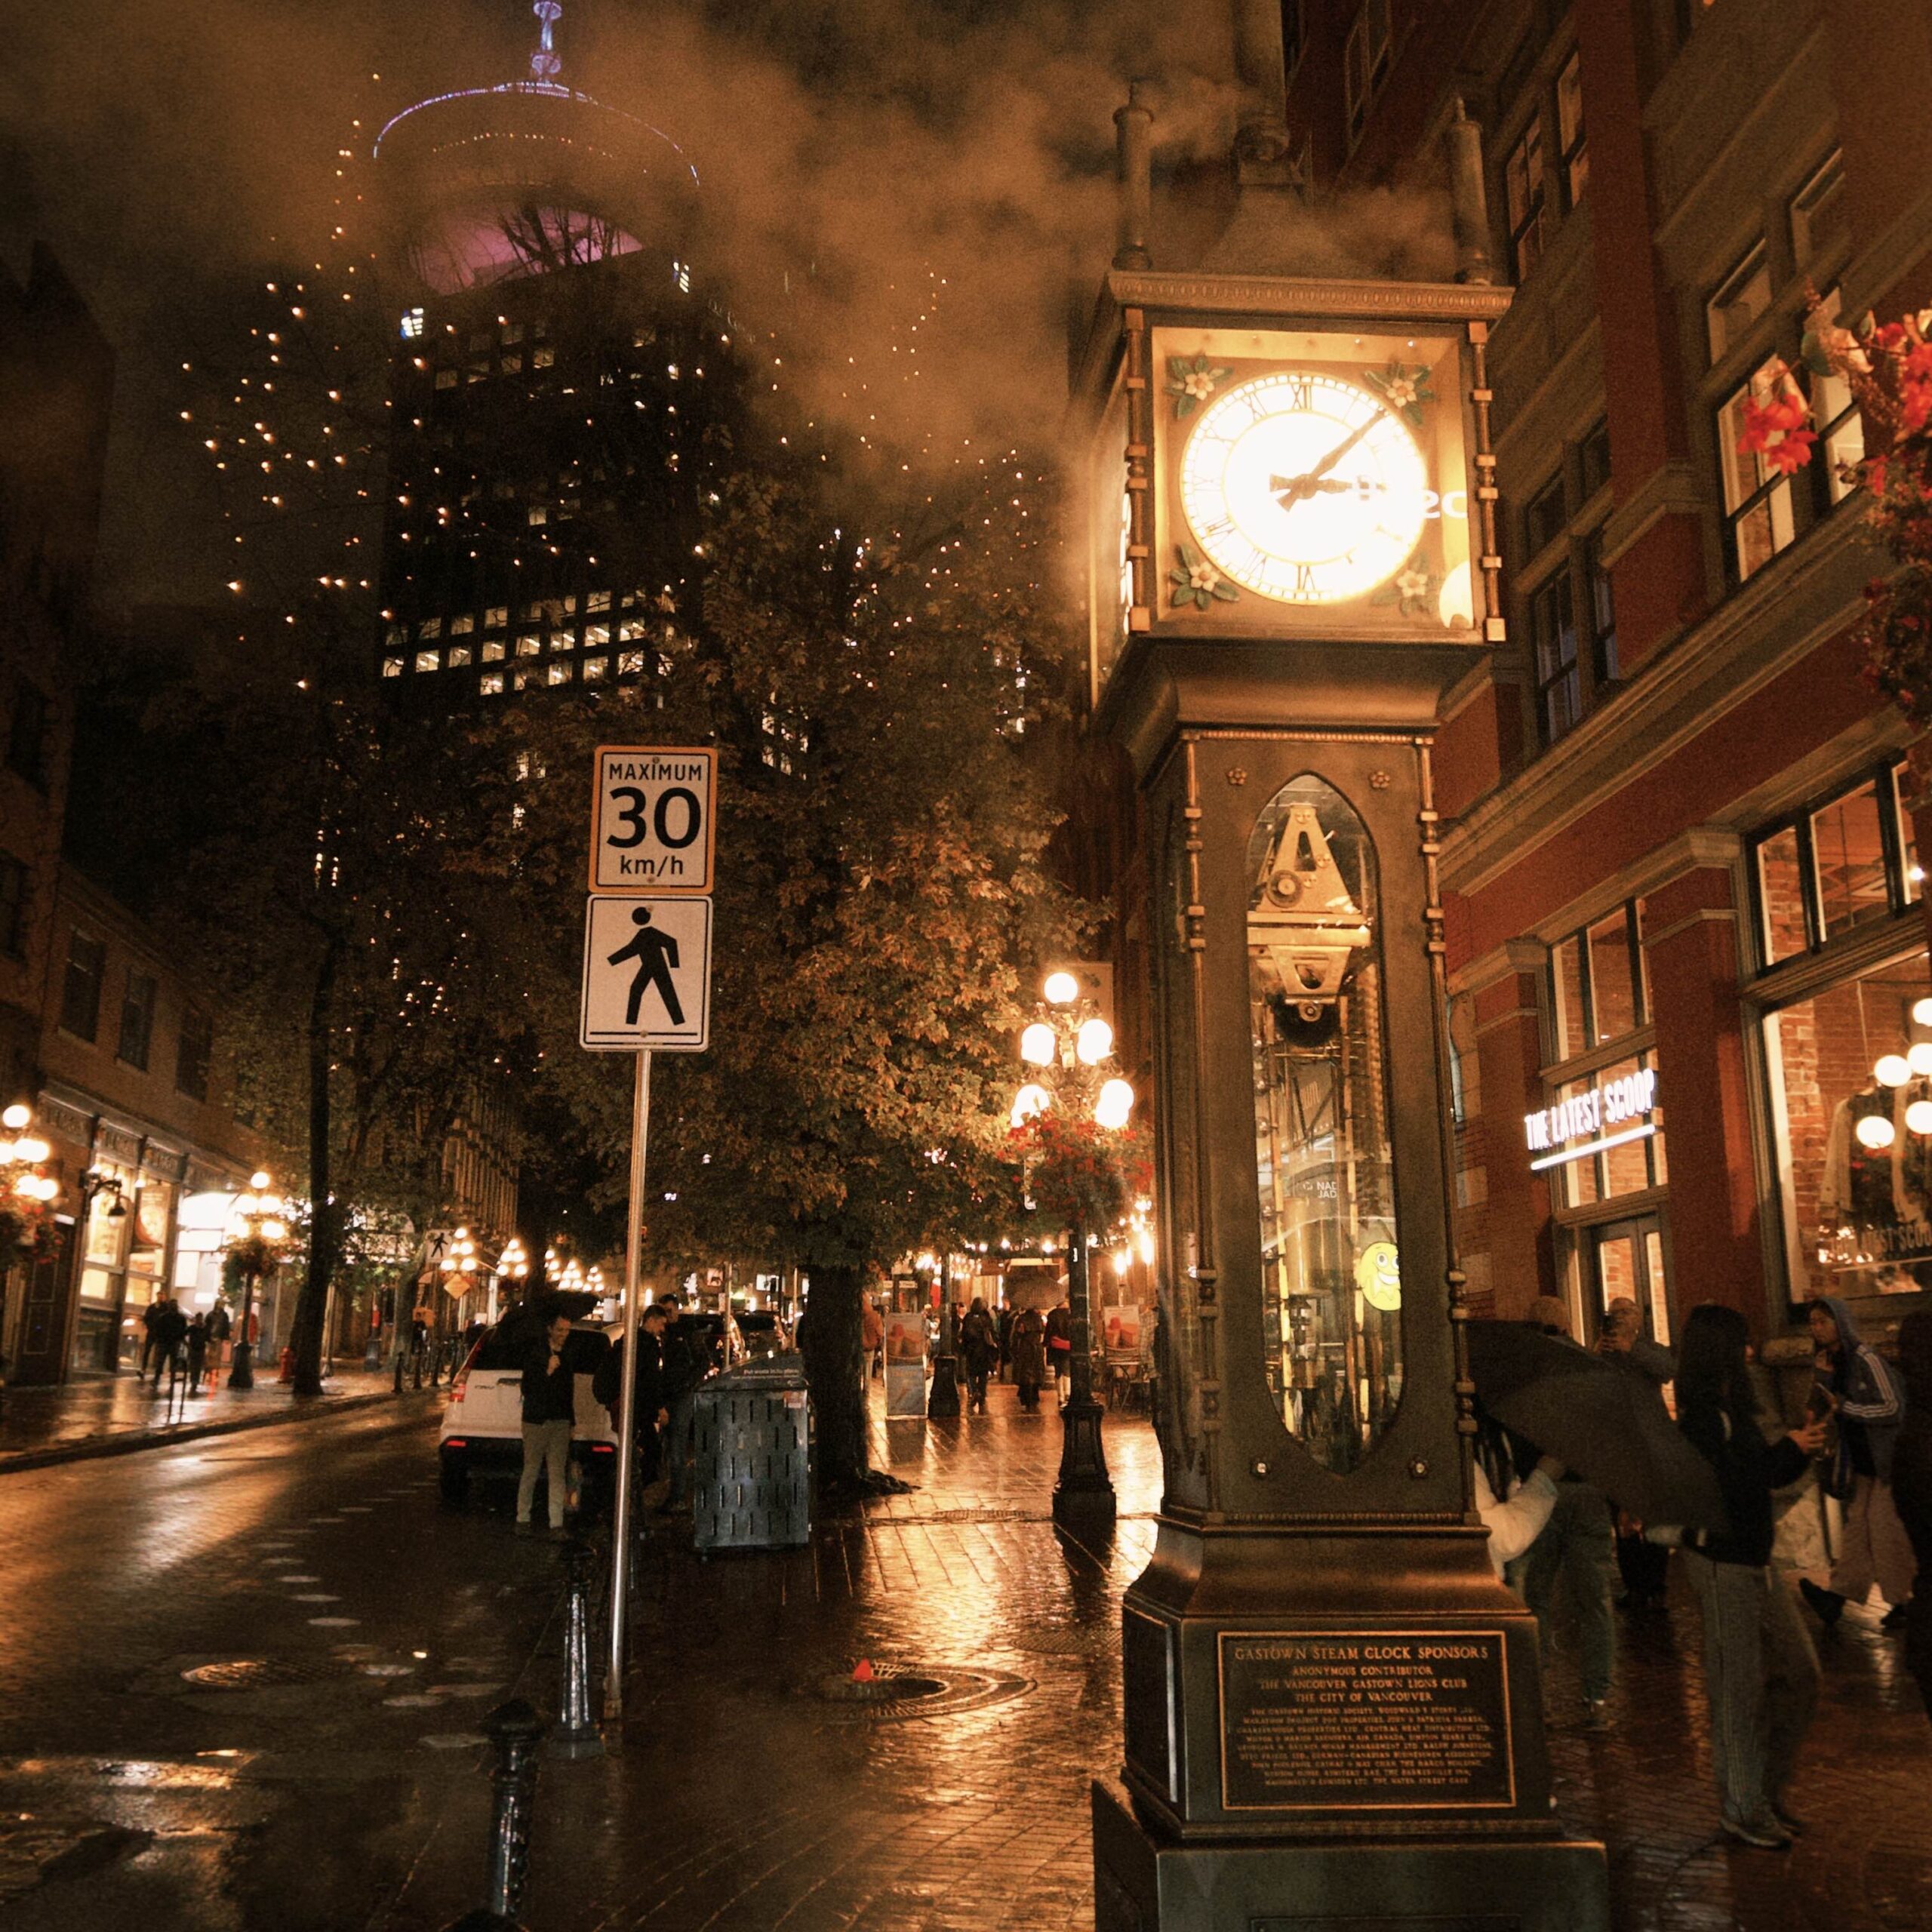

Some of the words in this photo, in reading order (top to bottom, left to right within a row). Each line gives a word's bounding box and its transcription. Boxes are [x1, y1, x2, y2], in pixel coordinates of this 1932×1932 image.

[609, 763, 702, 781] MAXIMUM
[606, 786, 701, 849] 30
[620, 854, 683, 877] km/h
[1524, 1110, 1550, 1150] THE
[1551, 1089, 1601, 1143] LATEST
[1604, 1068, 1654, 1124] SCOOP
[1235, 1647, 1306, 1660] GASTOWN
[1312, 1647, 1358, 1660] STEAM
[1364, 1646, 1411, 1660] CLOCK
[1418, 1647, 1488, 1660] SPONSORS
[1293, 1666, 1356, 1675] ANONYMOUS
[1361, 1666, 1433, 1675] CONTRIBUTOR
[1284, 1679, 1346, 1689] VANCOUVER
[1352, 1679, 1402, 1689] GASTOWN
[1407, 1678, 1437, 1689] LIONS
[1441, 1678, 1467, 1689] CLUB
[1296, 1693, 1315, 1703] THE
[1319, 1693, 1345, 1703] CITY
[1349, 1693, 1361, 1702] OF
[1367, 1692, 1433, 1702] VANCOUVER
